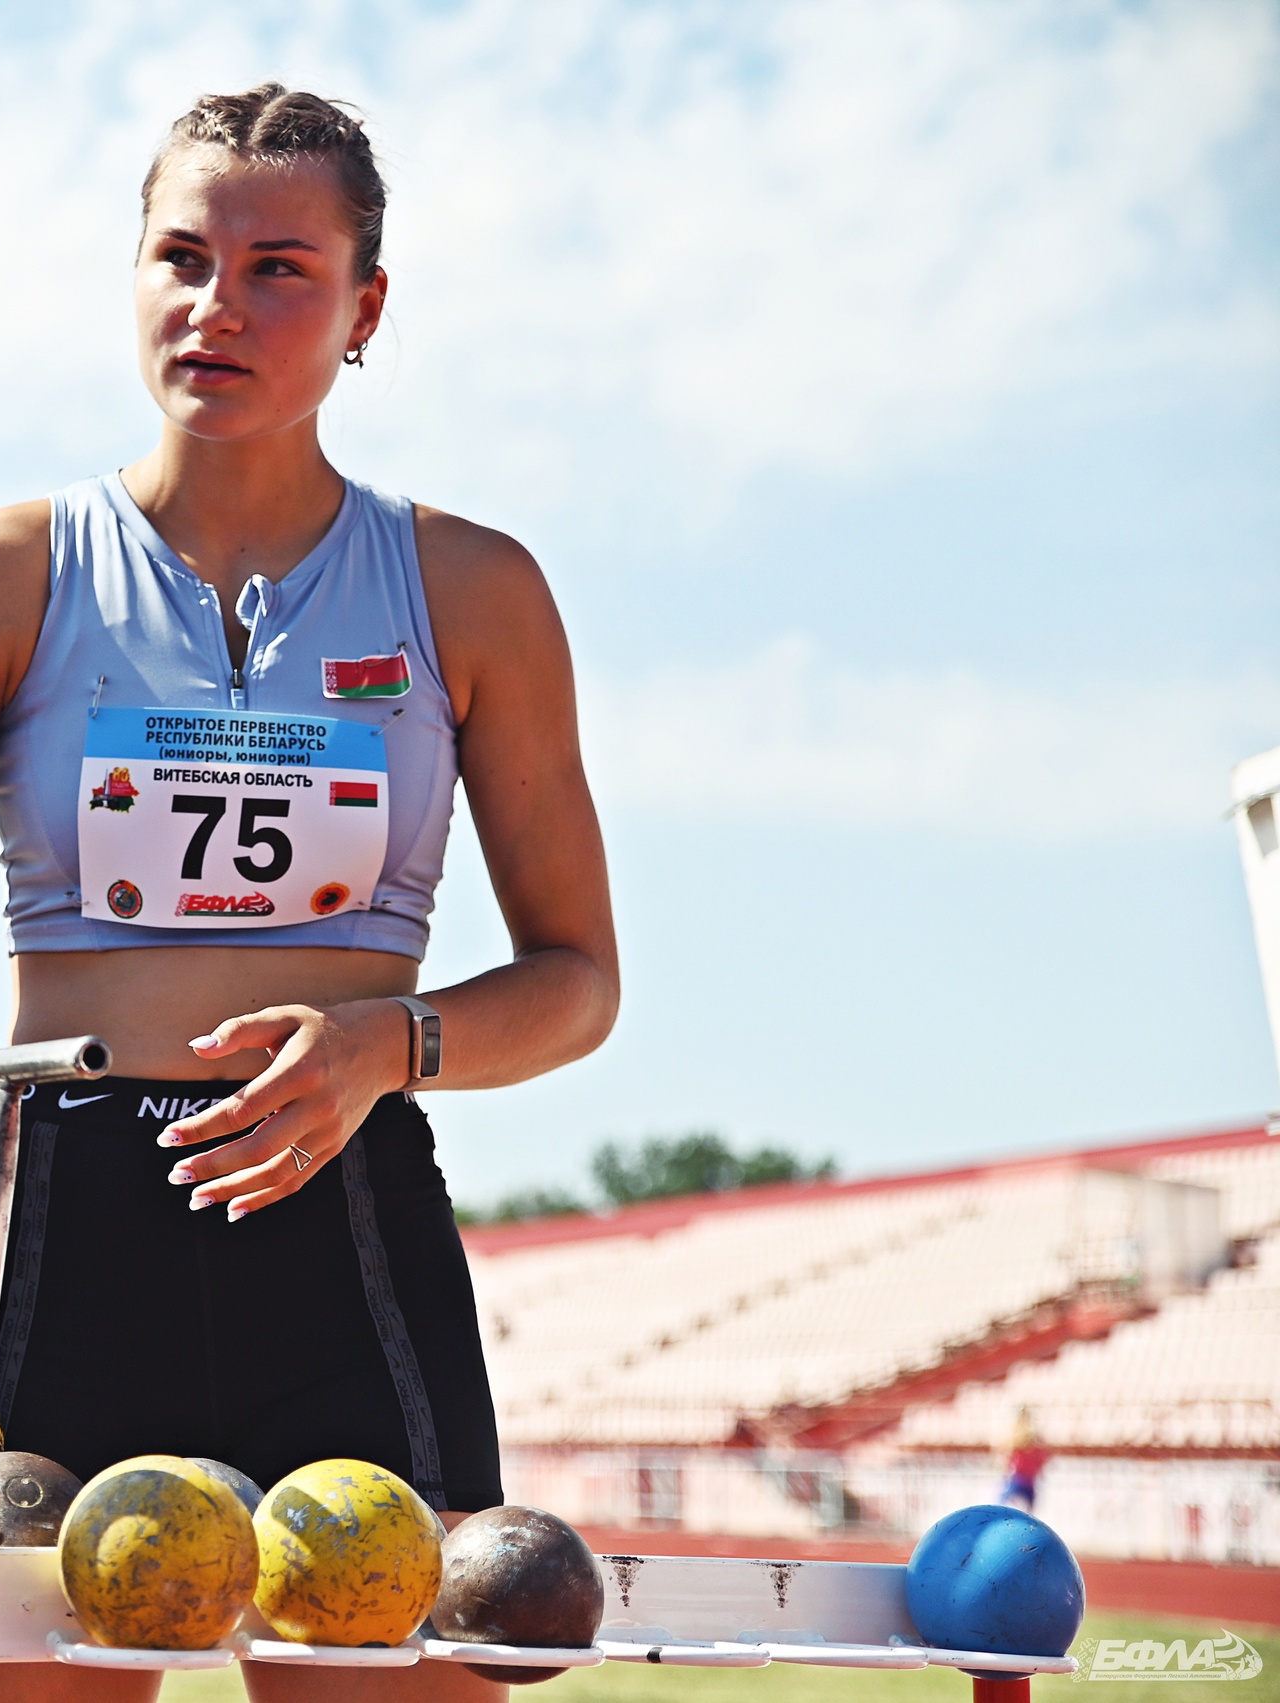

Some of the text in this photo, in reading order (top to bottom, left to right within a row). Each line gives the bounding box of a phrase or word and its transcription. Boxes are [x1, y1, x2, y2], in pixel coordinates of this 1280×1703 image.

[146, 716, 326, 737] ОТКРЫТОЕ ПЕРВЕНСТВО
[146, 731, 326, 751] РЕСПУБЛИКИ БЕЛАРУСЬ
[159, 746, 311, 767] (юниоры, юниорки)
[153, 768, 313, 788] ВИТЕБСКАЯ ОБЛАСТЬ
[171, 794, 293, 883] 75
[187, 894, 251, 912] БФЛА
[137, 1096, 221, 1120] NIK
[396, 1378, 419, 1437] NIKE PRO
